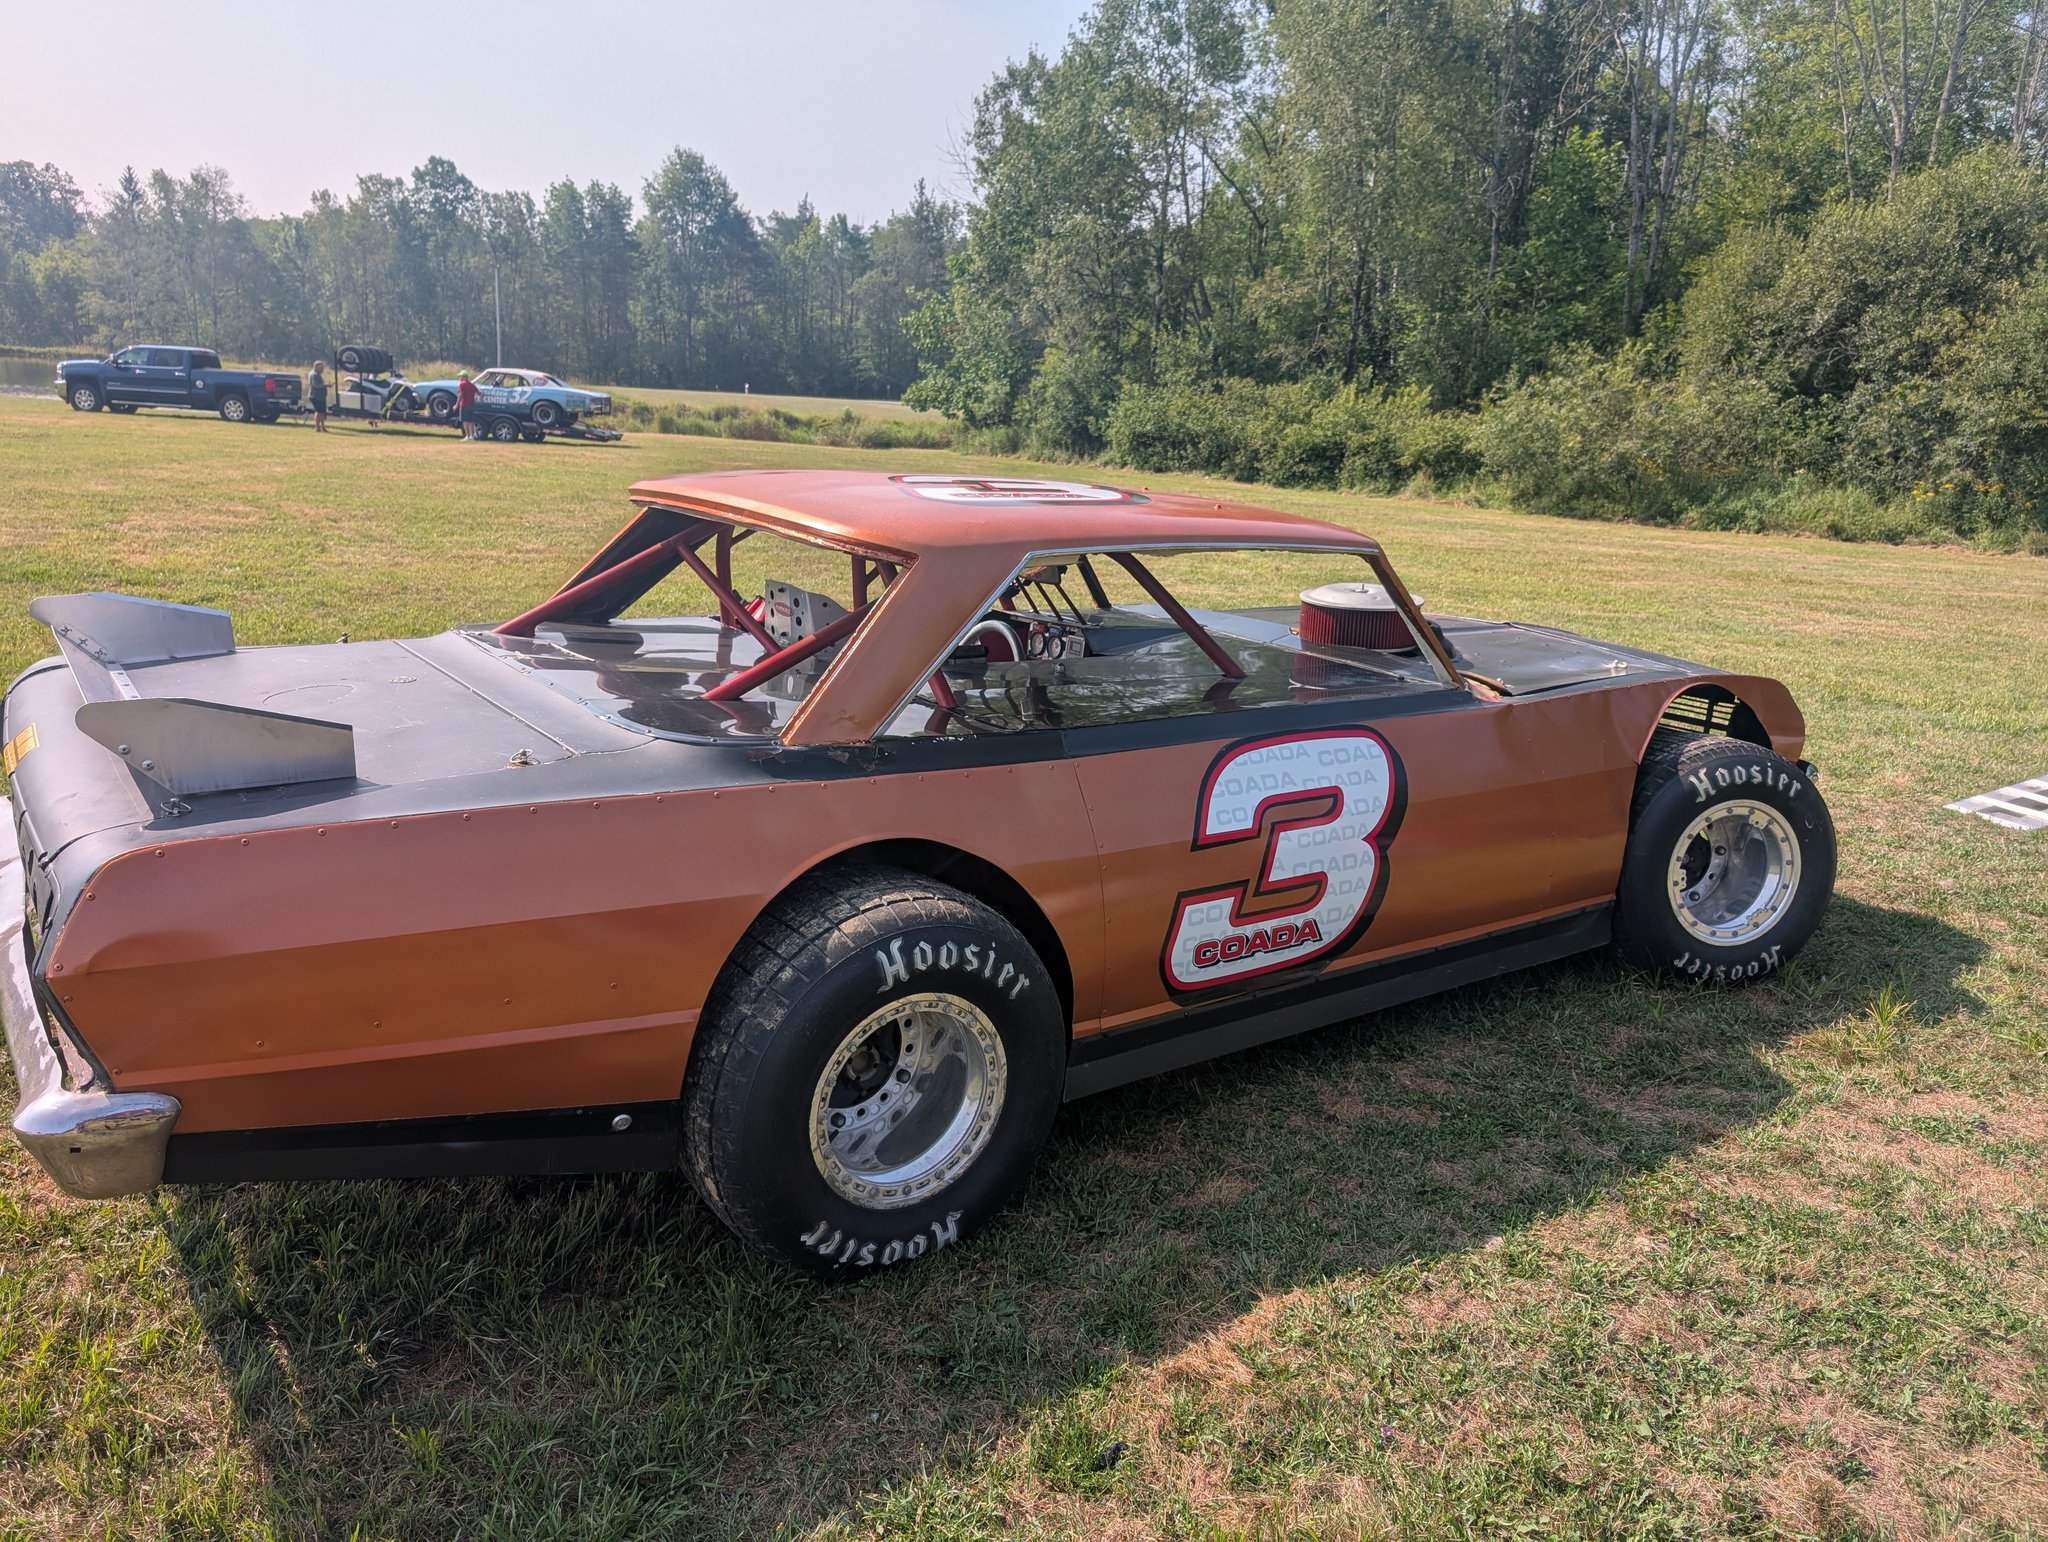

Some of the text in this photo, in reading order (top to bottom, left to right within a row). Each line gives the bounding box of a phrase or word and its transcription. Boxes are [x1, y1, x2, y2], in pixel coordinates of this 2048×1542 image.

[509, 386, 532, 405] 32
[1688, 762, 1802, 803] Hoosier
[1297, 823, 1369, 848] COADA
[1162, 727, 1400, 998] 3
[1193, 918, 1323, 968] COADA
[1674, 945, 1781, 983] Hoosier
[875, 936, 1030, 1000] Hoosier
[801, 1210, 964, 1269] Hoosier
